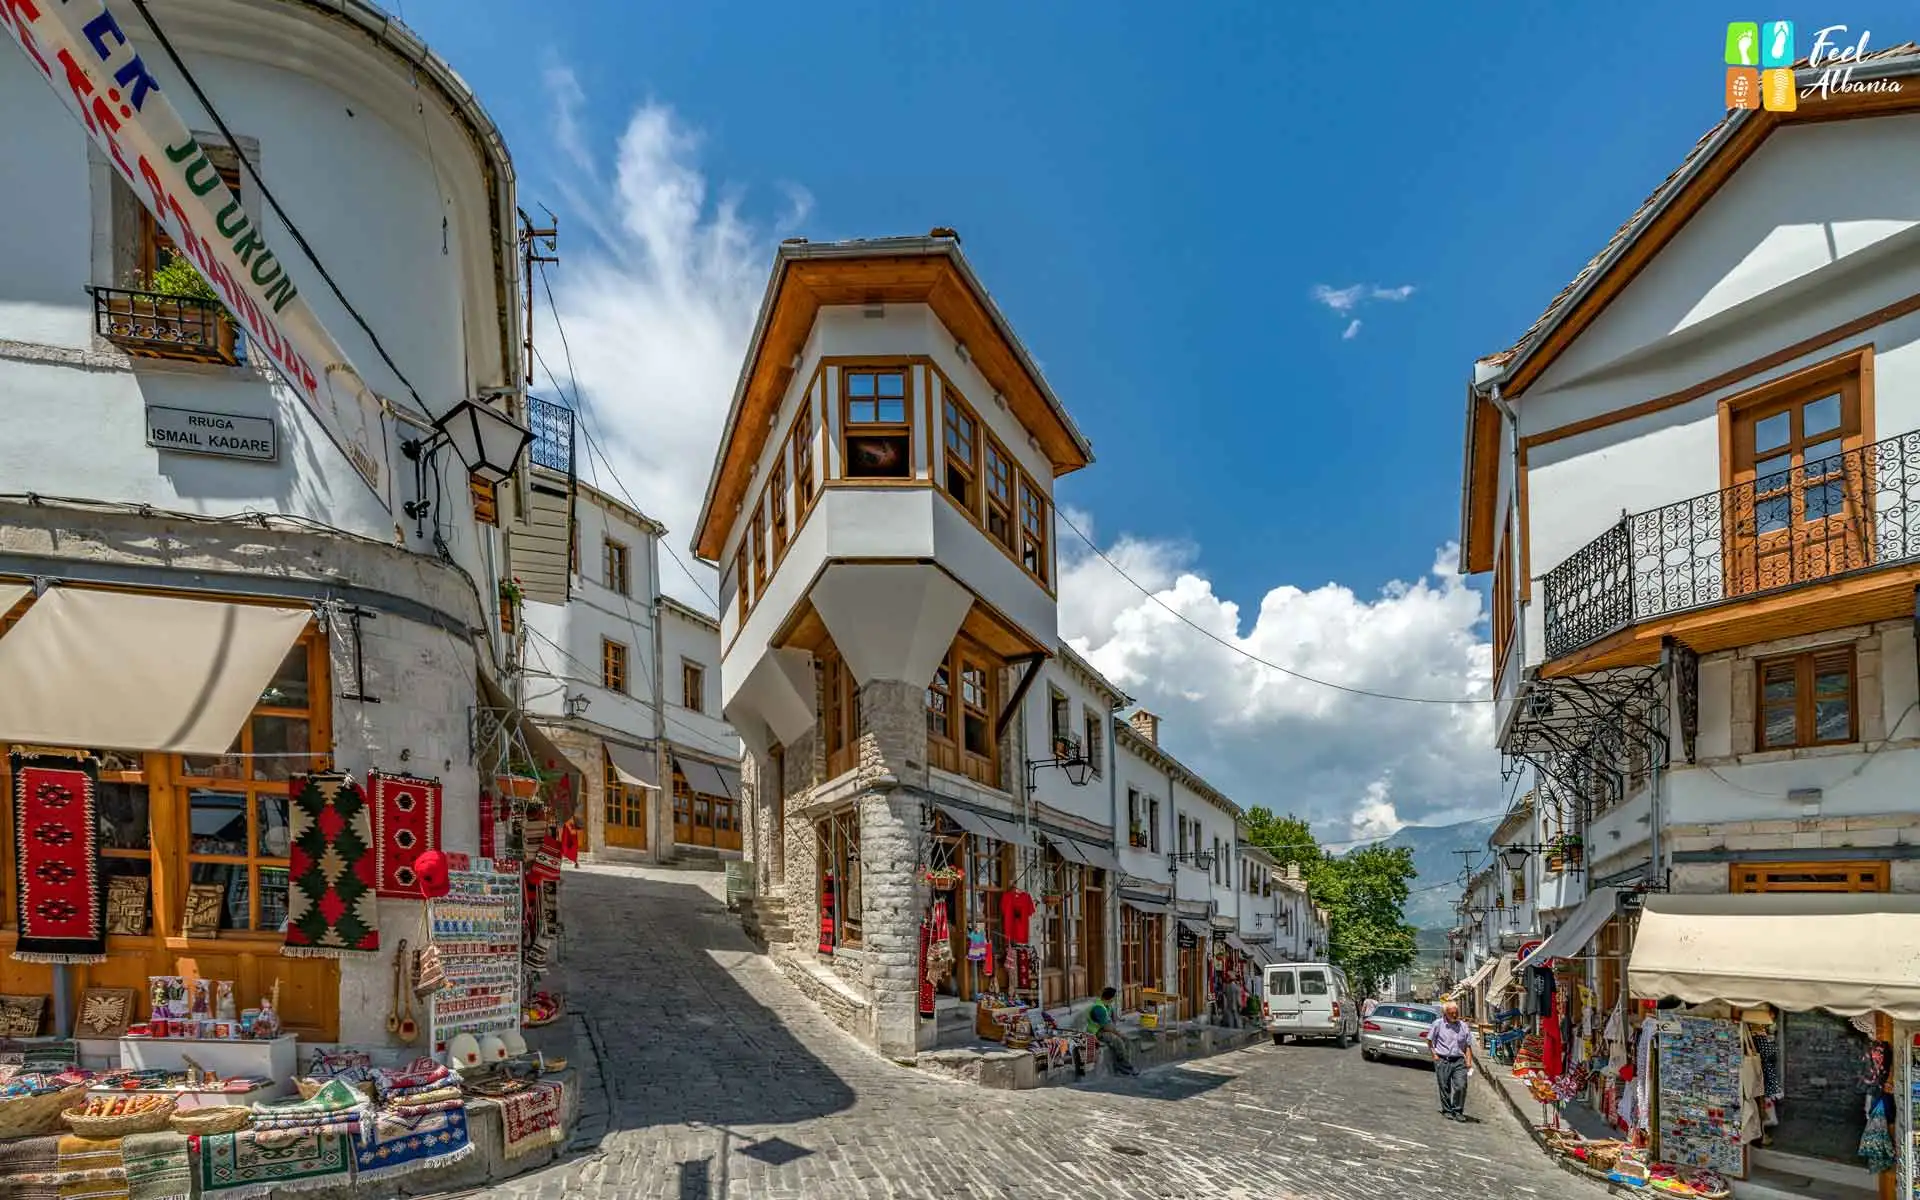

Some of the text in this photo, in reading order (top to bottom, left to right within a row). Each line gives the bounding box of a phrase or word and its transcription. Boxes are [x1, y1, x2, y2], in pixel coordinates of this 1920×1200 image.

[165, 137, 222, 197] JU
[188, 415, 235, 431] RRUGA
[151, 428, 271, 452] ISMAIL KADARE
